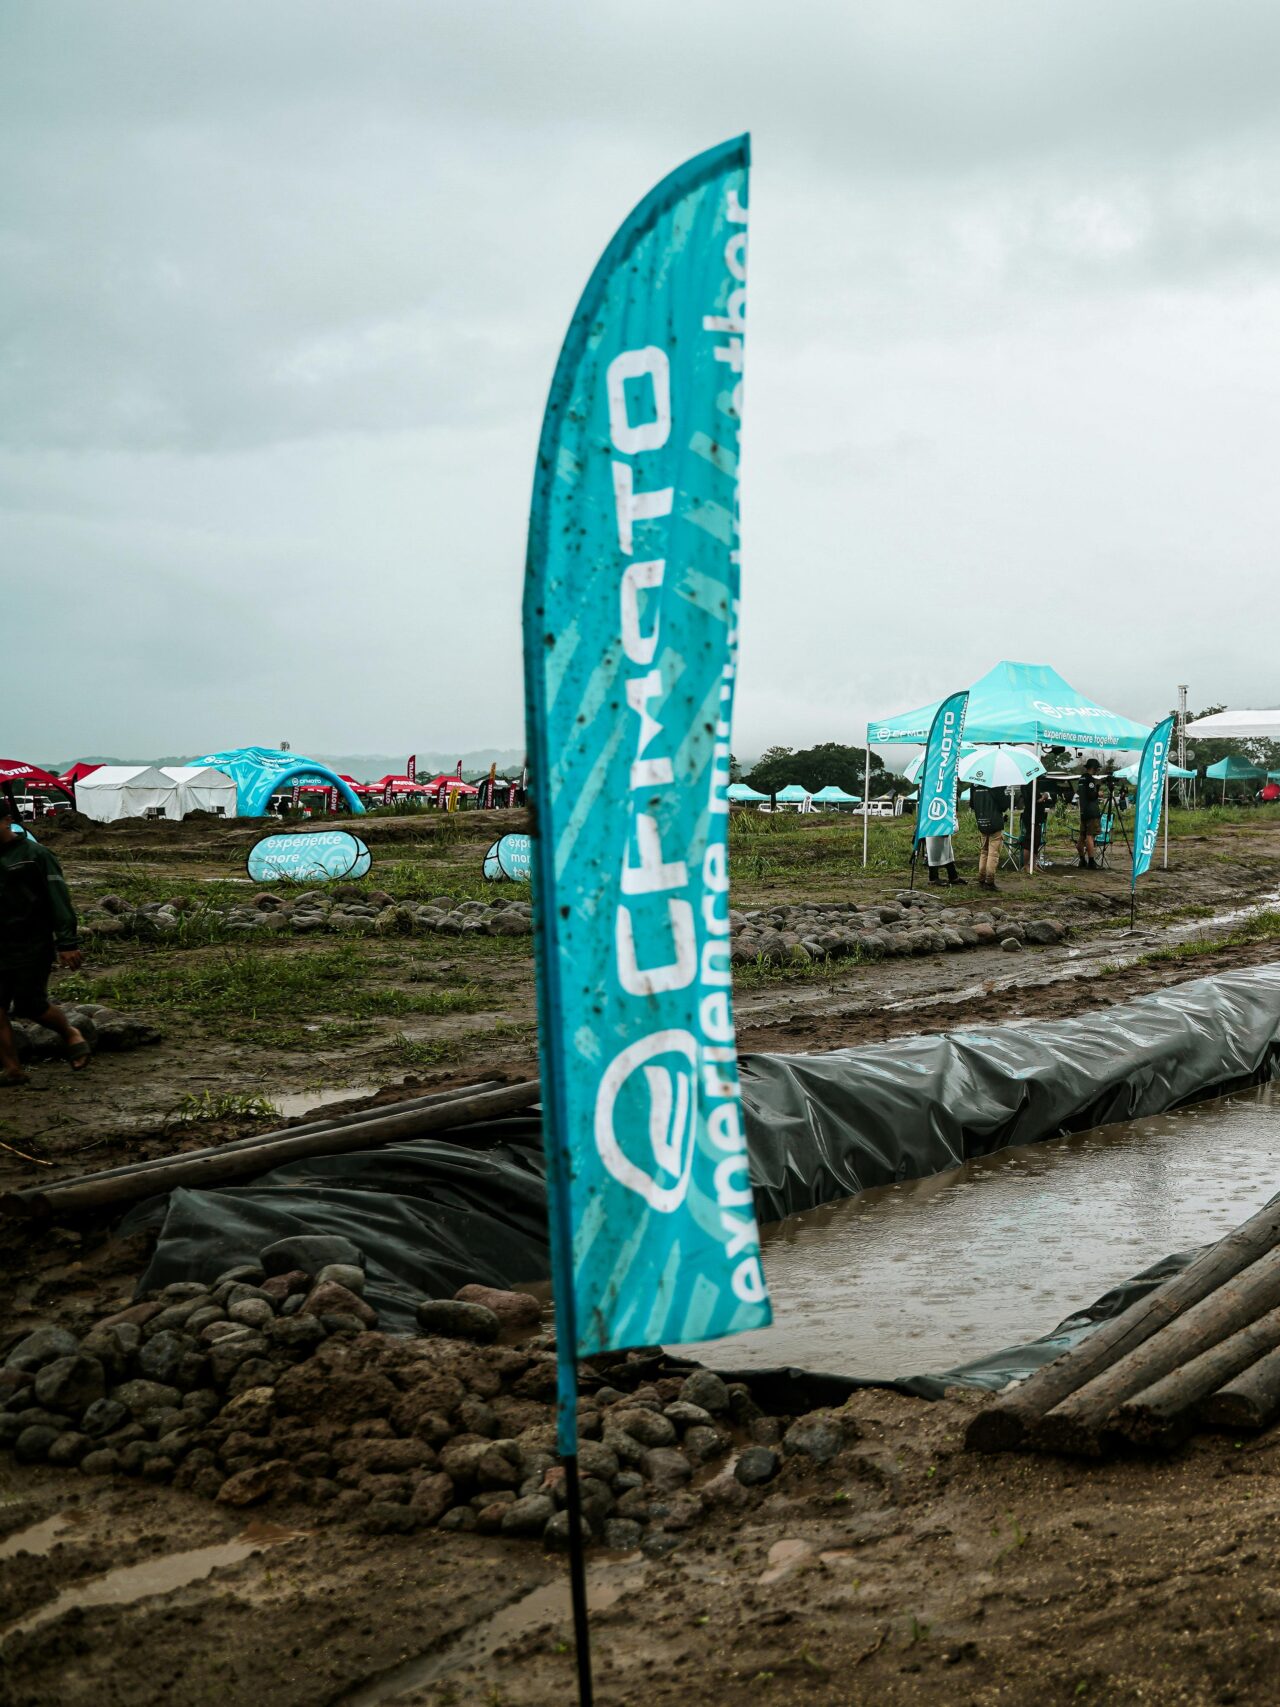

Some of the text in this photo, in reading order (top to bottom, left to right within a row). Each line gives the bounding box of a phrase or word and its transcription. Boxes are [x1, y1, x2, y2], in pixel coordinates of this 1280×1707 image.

[607, 345, 698, 997] CFMOTO
[892, 729, 929, 737] CFMOT
[1043, 728, 1119, 747] experience more together
[936, 711, 955, 793] CFMOTO
[267, 835, 341, 851] experience
[265, 853, 299, 864] more
[511, 853, 530, 863] mor
